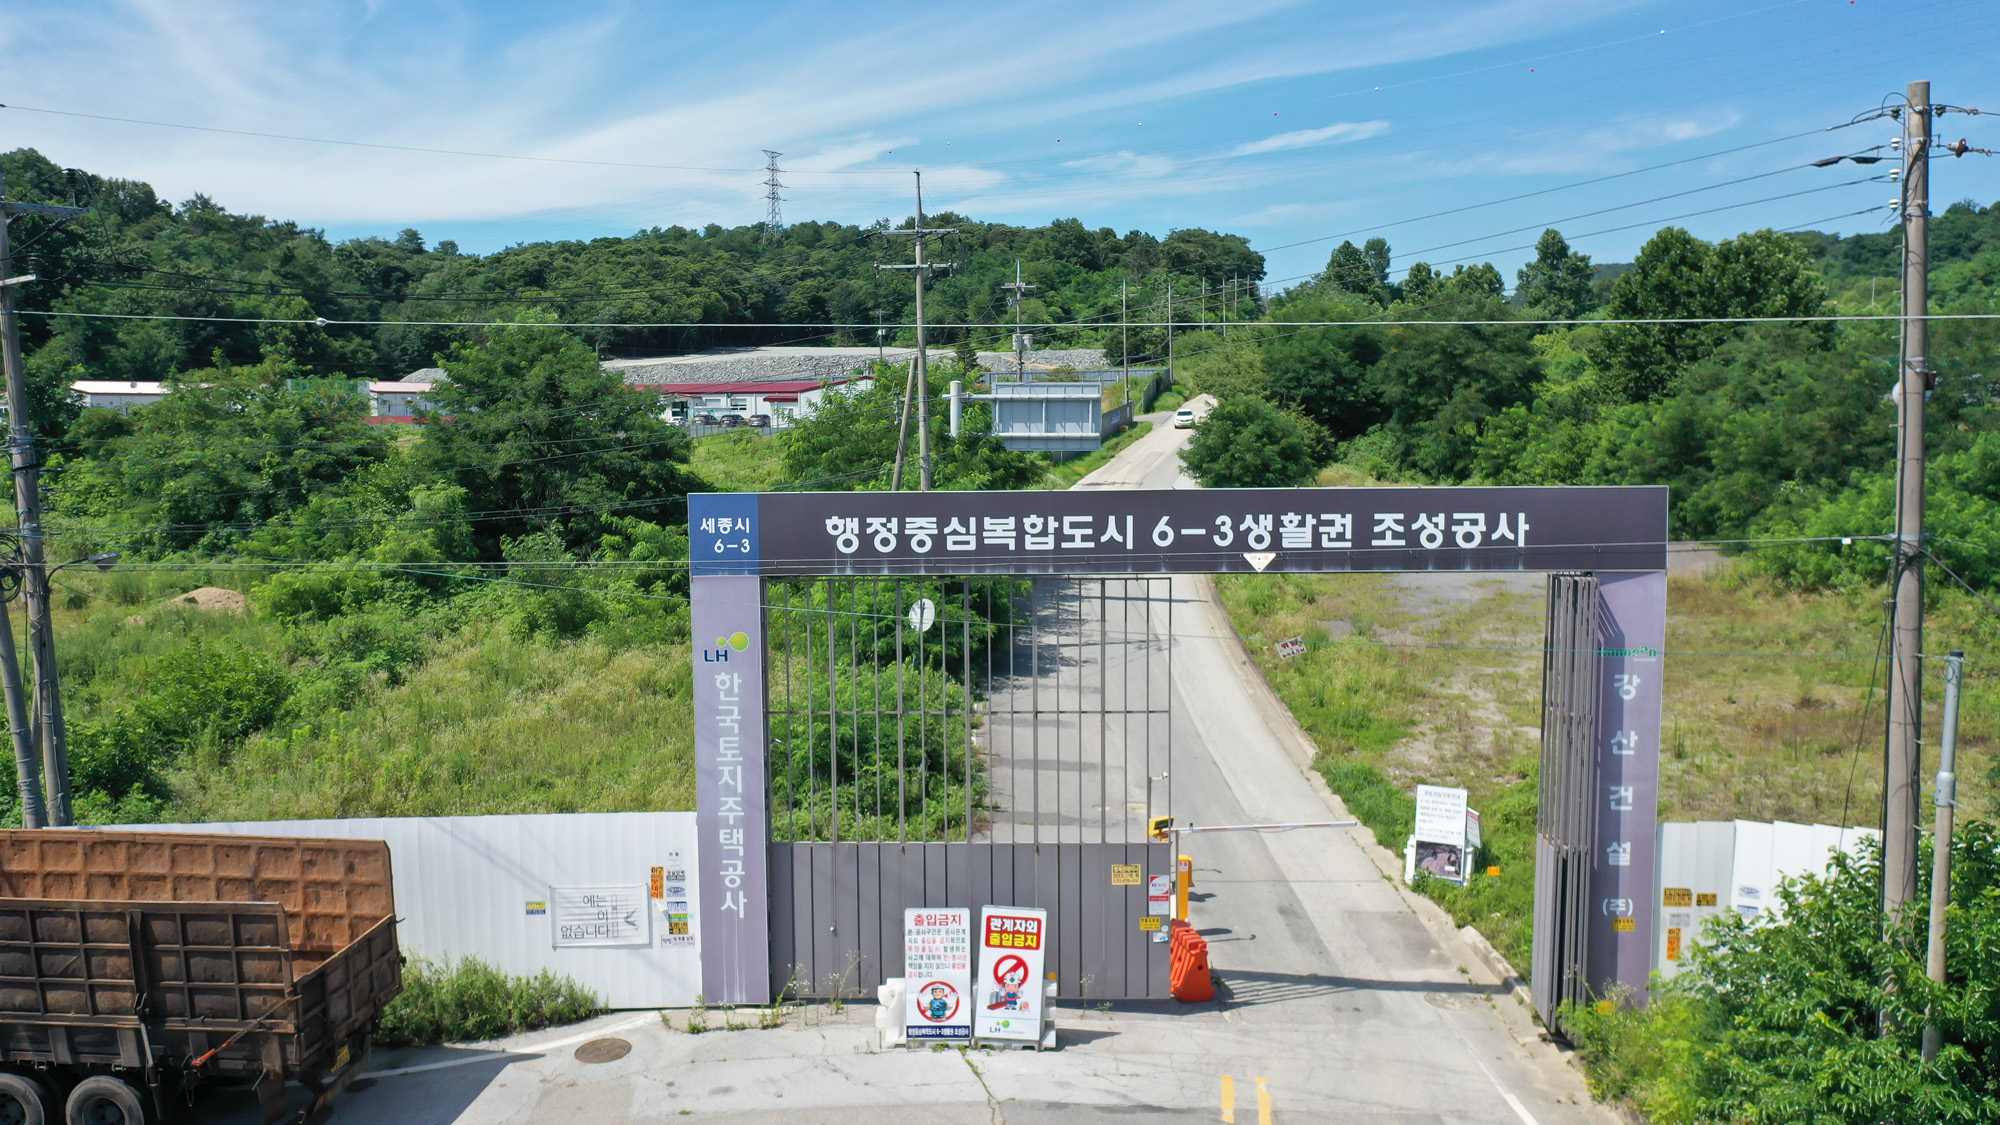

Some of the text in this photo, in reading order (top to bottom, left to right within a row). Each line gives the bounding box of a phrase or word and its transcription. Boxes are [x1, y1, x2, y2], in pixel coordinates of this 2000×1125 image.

[700, 516, 751, 534] 세종시
[825, 512, 1530, 554] 행정중심복합도시 6-3생활권 조성공사
[713, 539, 751, 554] 6-3
[704, 649, 729, 663] LH
[715, 672, 748, 919] 한국토지주택공사
[583, 894, 608, 908] 에는
[597, 909, 608, 922] 이
[914, 914, 961, 926] 출입금지
[561, 924, 610, 939] 없습니다
[990, 917, 1038, 933] 관계자외
[990, 932, 1037, 948] 출입금지
